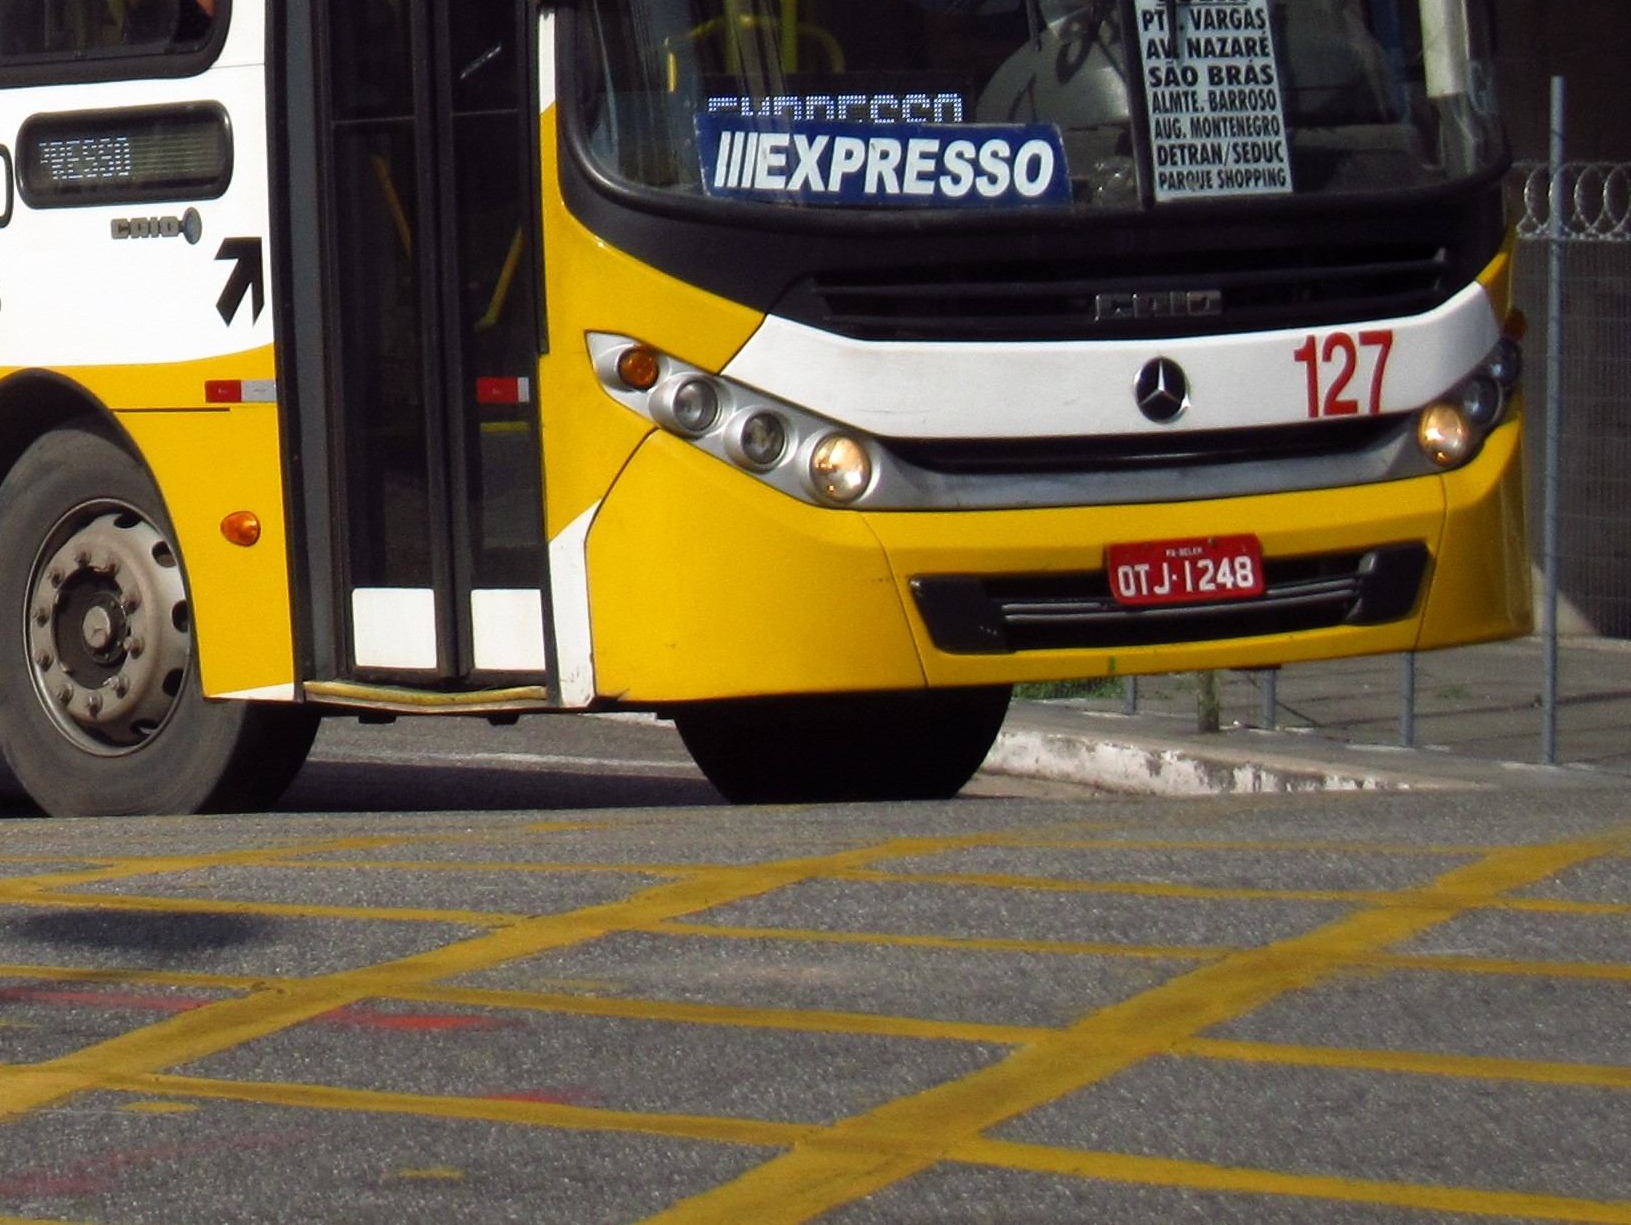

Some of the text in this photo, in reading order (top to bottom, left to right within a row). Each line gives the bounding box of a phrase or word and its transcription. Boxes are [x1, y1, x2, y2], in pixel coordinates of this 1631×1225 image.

[1142, 8, 1267, 31] PT. VARGAS
[1187, 31, 1270, 59] NAZARÉ
[1148, 59, 1275, 88] SÃO BRÁS
[1152, 89, 1277, 114] ALMTE. BARROSO
[1154, 115, 1280, 140] AUG. MONTENEGRO
[1157, 141, 1284, 166] DETRAN/SEDUC
[1159, 168, 1286, 192] PARQUE SHOPPING
[1294, 329, 1394, 419] 127
